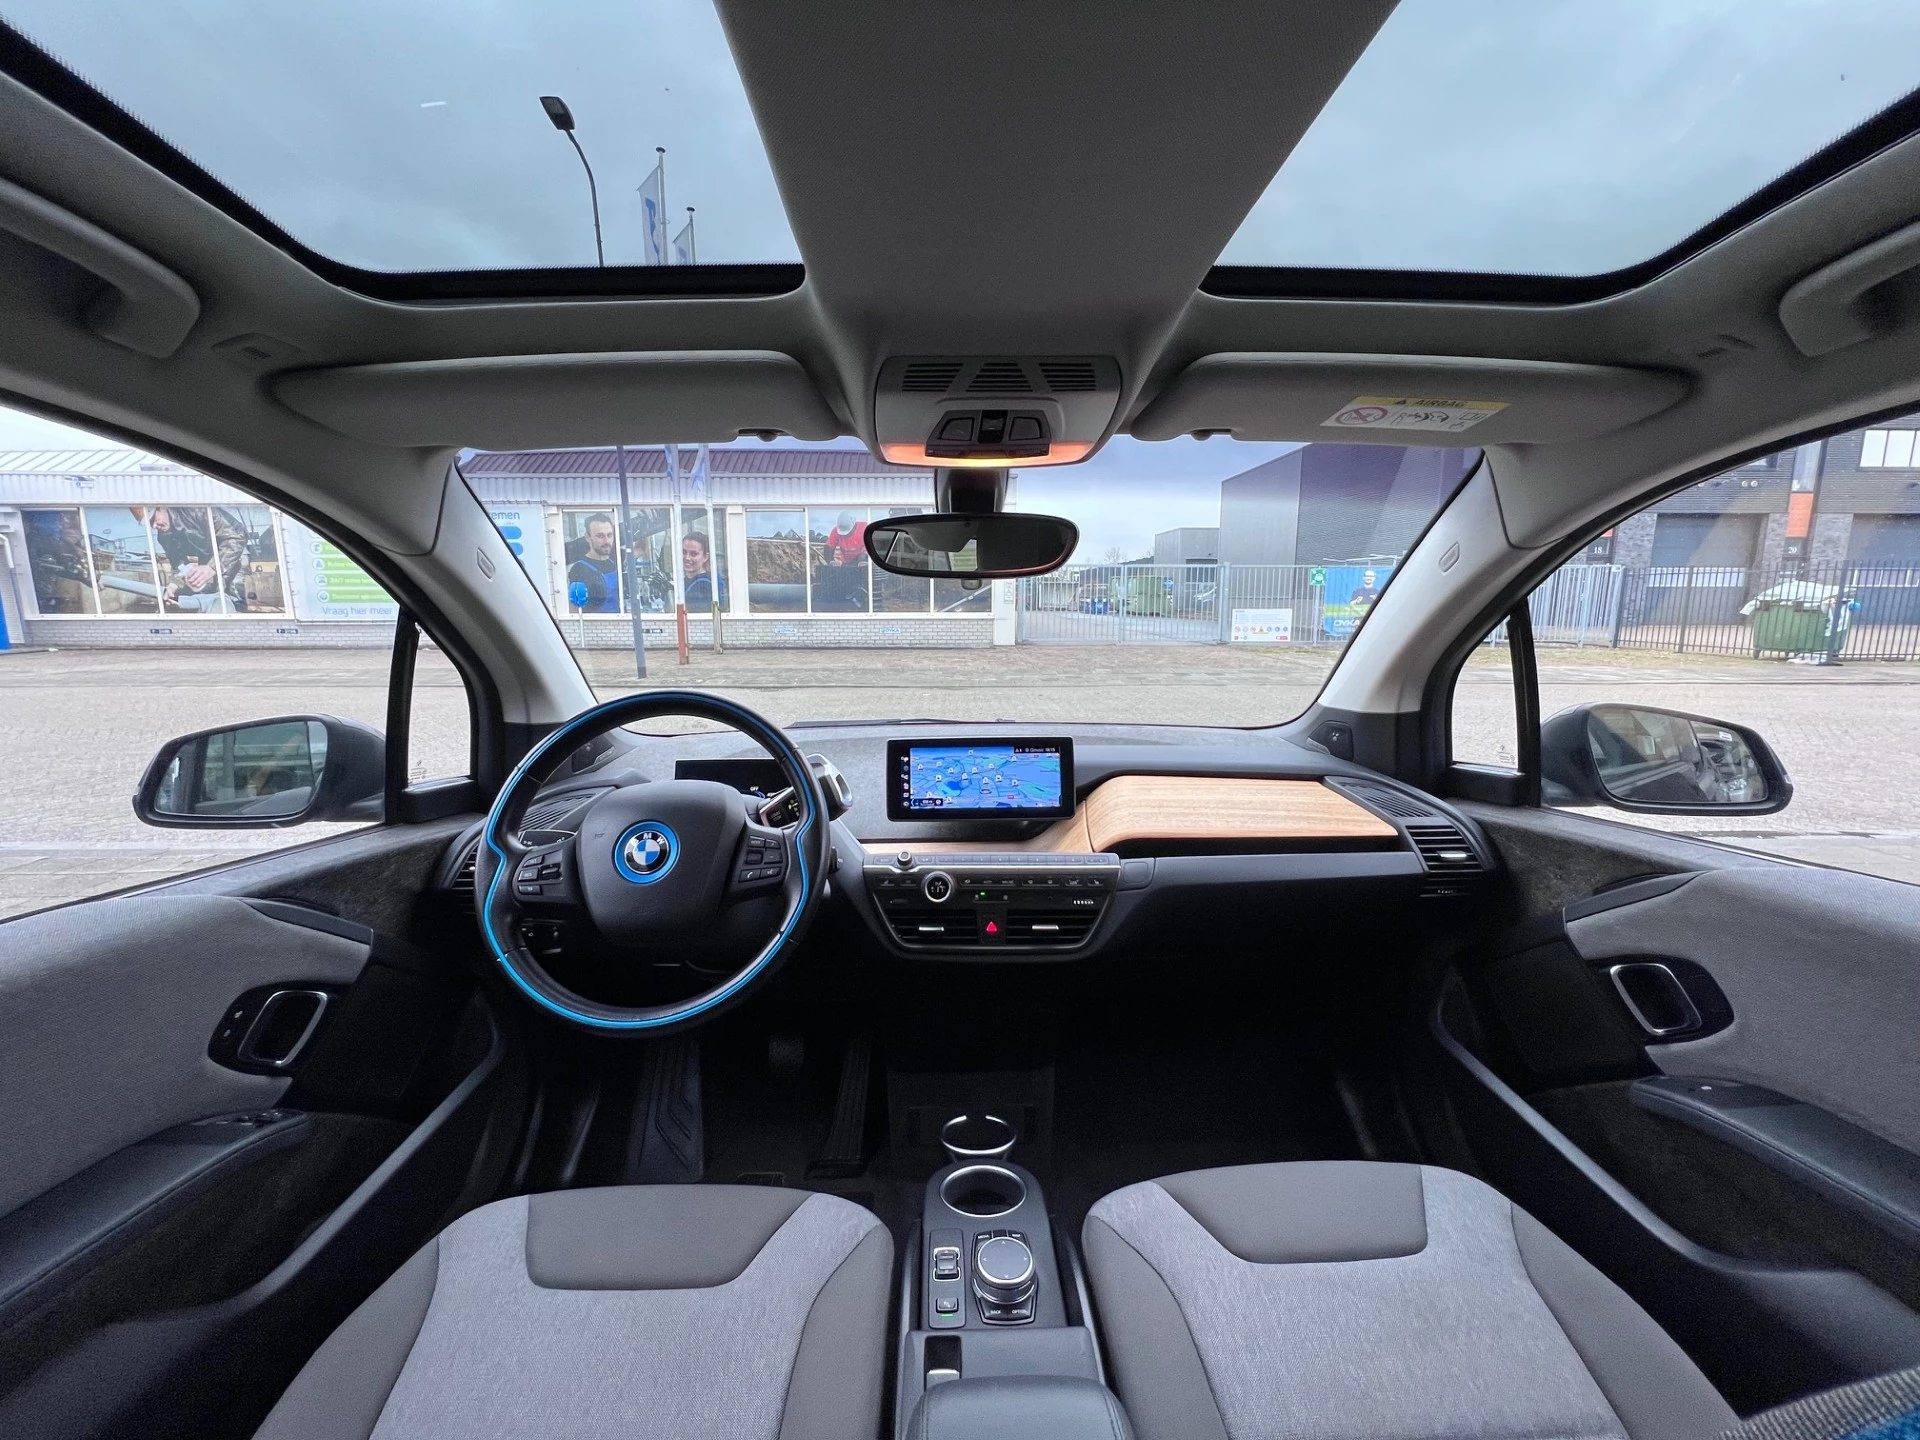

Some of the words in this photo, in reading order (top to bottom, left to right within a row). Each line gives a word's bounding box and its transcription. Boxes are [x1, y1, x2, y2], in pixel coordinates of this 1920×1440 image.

[1414, 399, 1468, 408] AIRBAG
[490, 511, 520, 520] emen
[1593, 546, 1603, 554] 18
[1787, 546, 1798, 554] 20
[321, 606, 349, 617] Vraag
[351, 606, 368, 615] hier
[1333, 619, 1360, 627] DYKA
[630, 832, 666, 847] BMW
